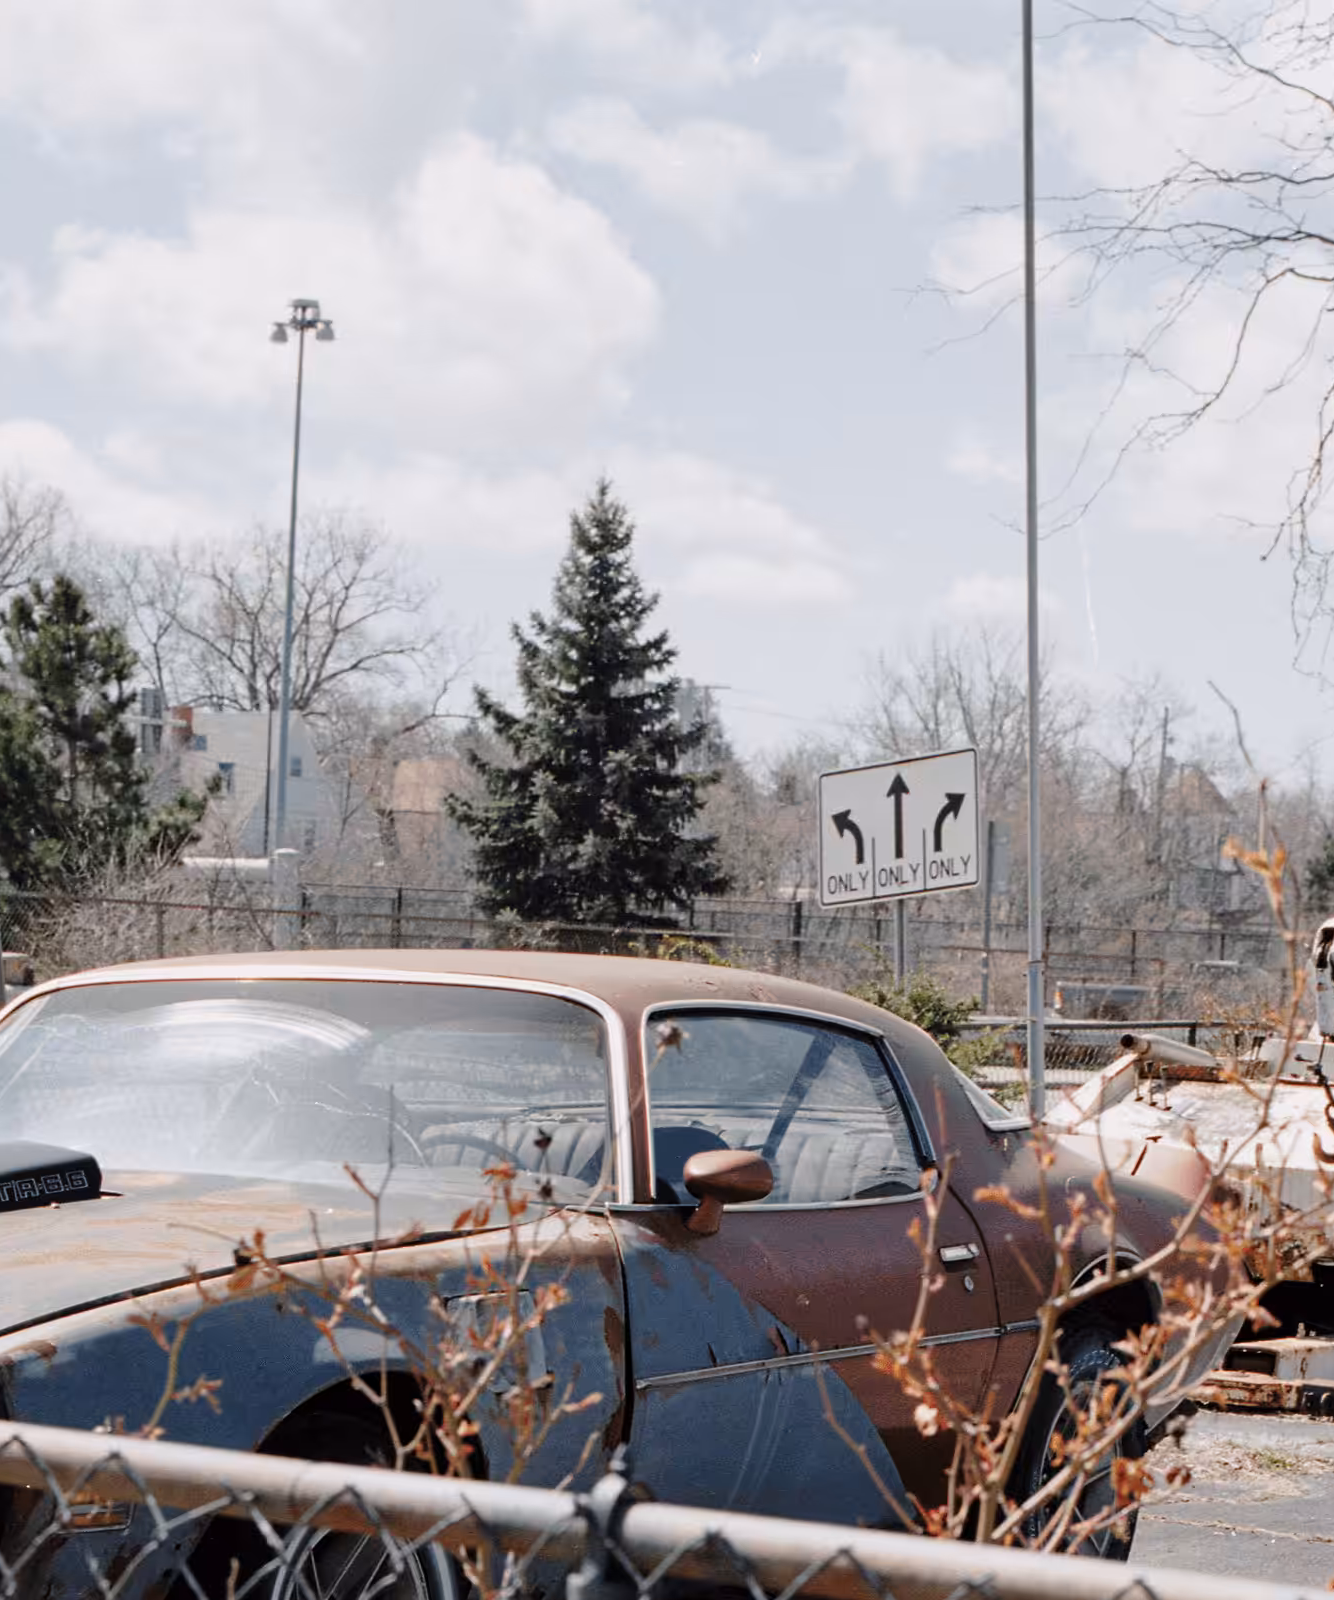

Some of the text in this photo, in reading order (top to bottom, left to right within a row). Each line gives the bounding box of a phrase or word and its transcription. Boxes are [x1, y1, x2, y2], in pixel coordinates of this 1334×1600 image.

[827, 855, 971, 895] ONLY ONLY ONLY
